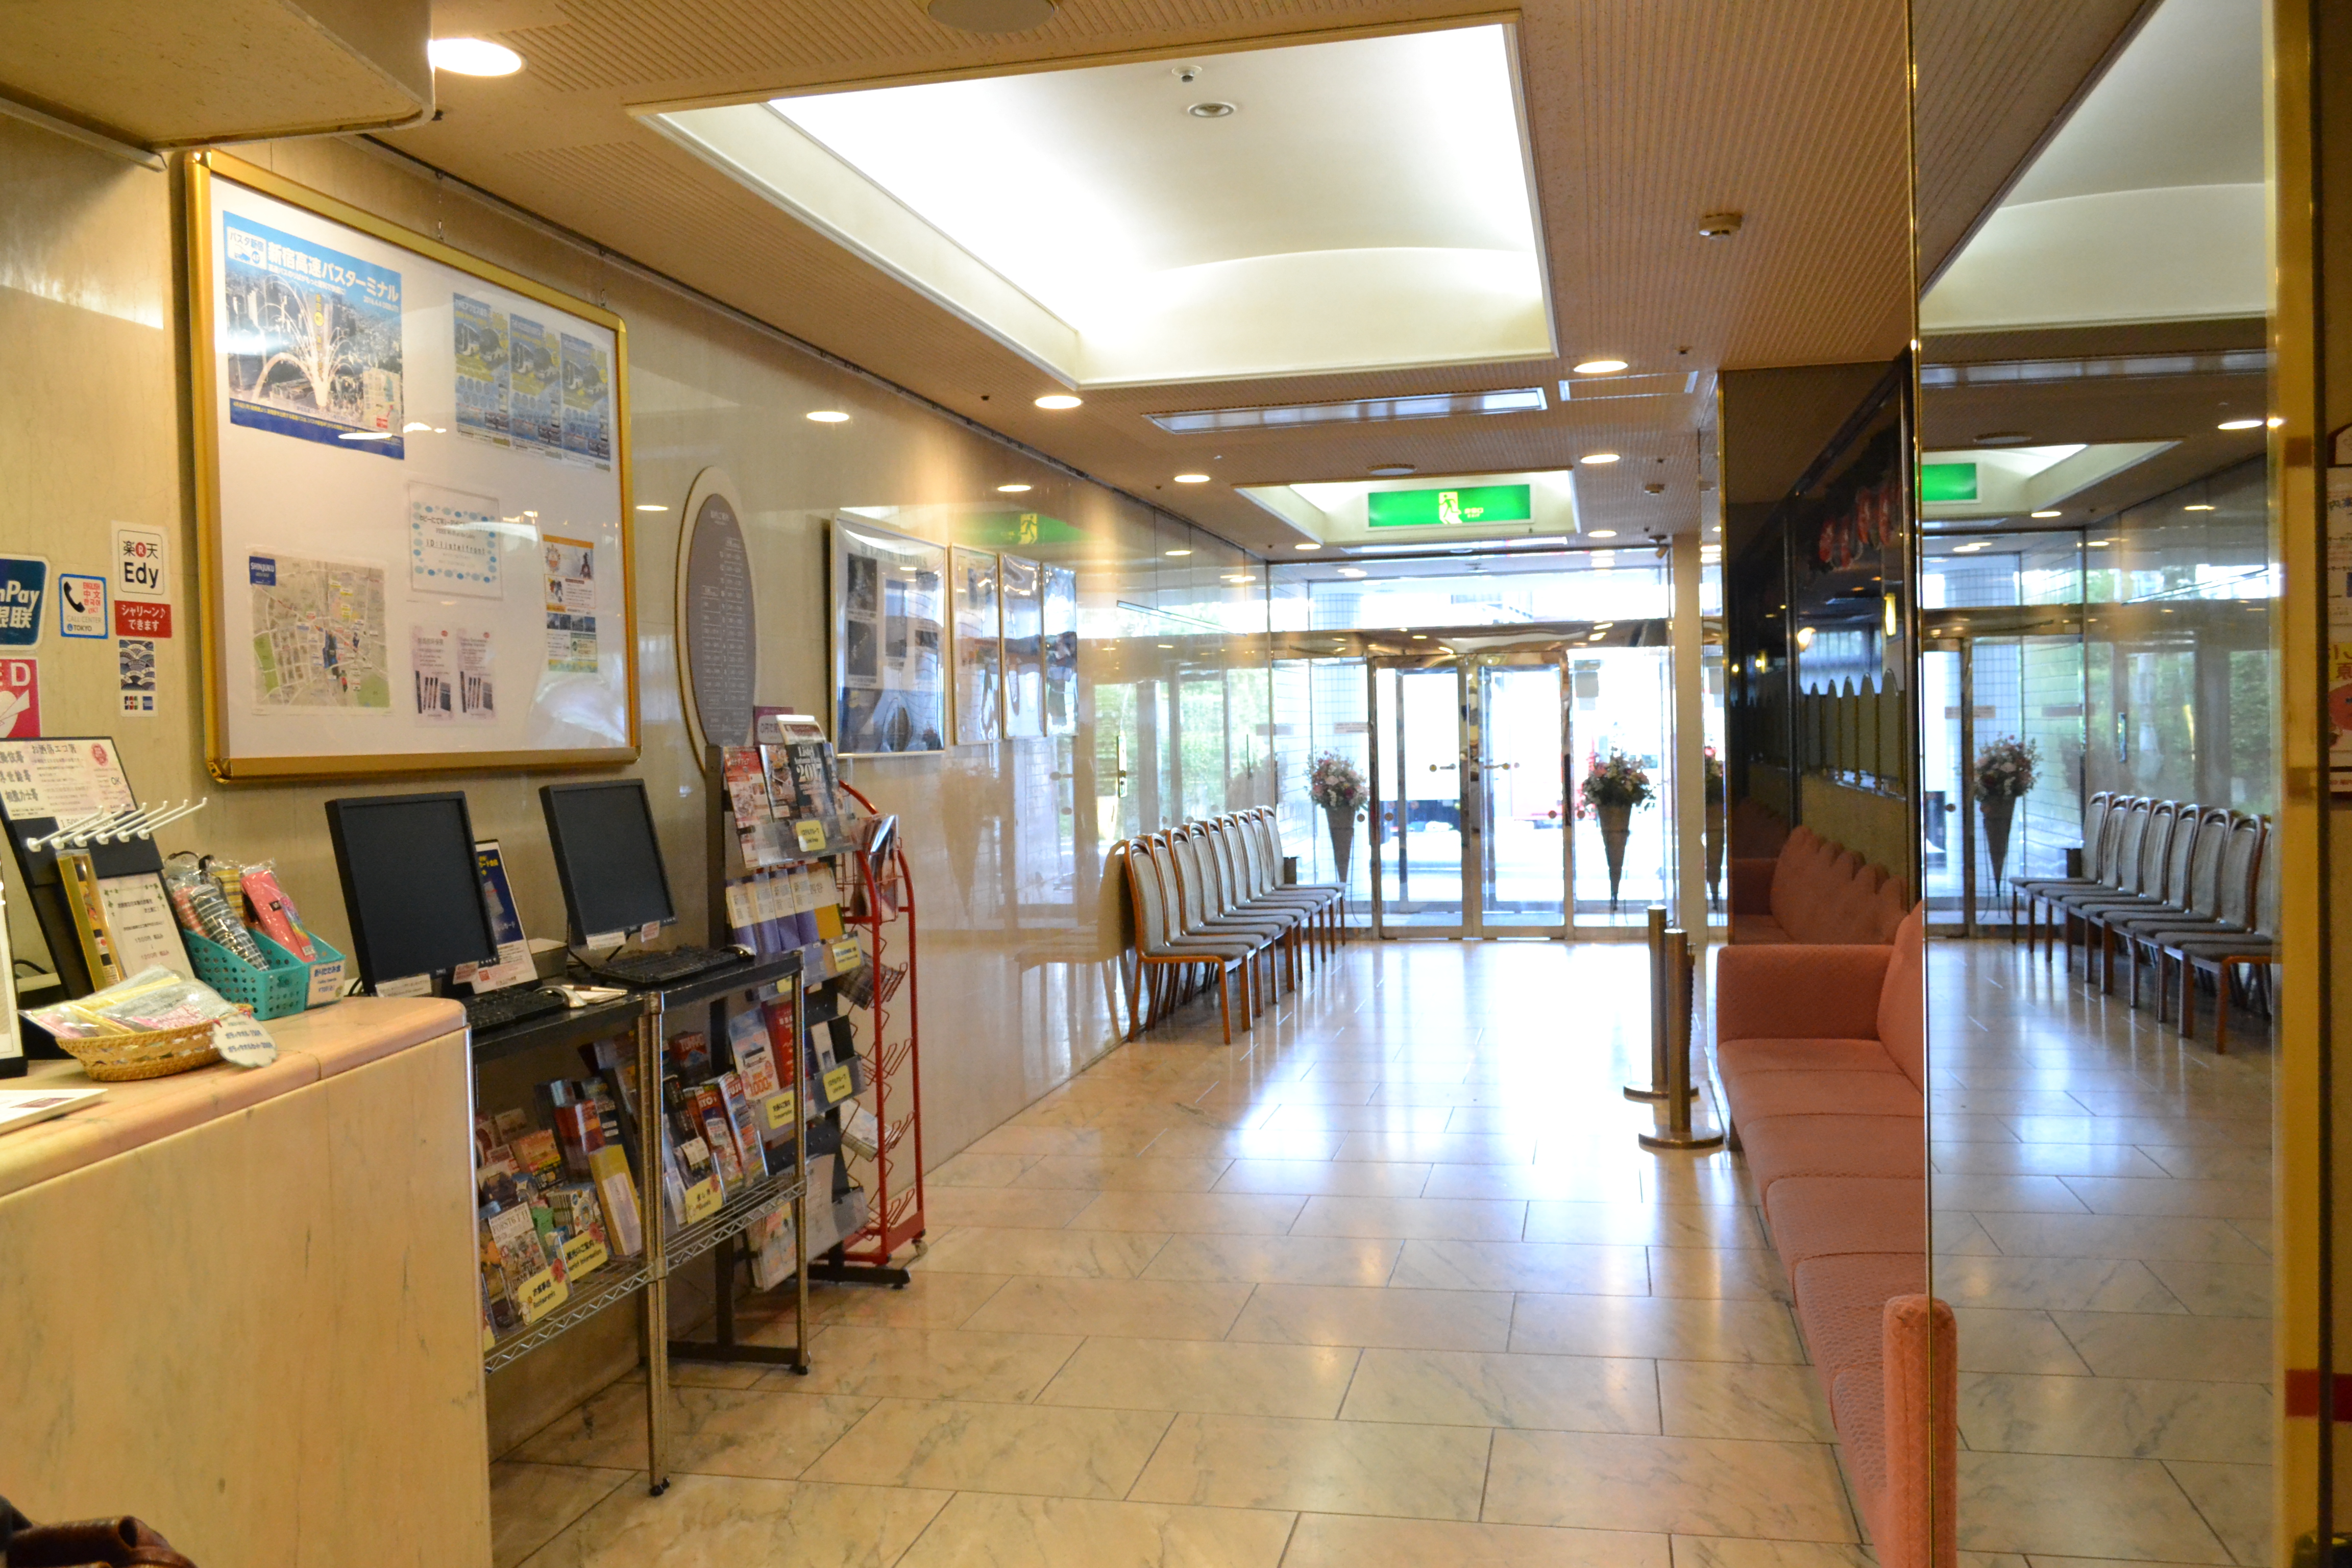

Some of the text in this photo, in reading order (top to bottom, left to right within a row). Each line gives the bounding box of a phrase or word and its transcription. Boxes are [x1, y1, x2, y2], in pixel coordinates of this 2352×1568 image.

[230, 232, 264, 252] バスタ新宿
[267, 241, 399, 302] 新宿高速バスターミナル
[250, 562, 275, 573] SHINJUKU
[124, 561, 159, 589] Edy
[83, 582, 101, 590] ENGLISH
[128, 619, 160, 632] できます
[32, 744, 77, 754] お洒落エコ箸
[796, 764, 822, 783] 2017
[111, 777, 122, 785] OK
[314, 965, 341, 977] 折りたたみ傘
